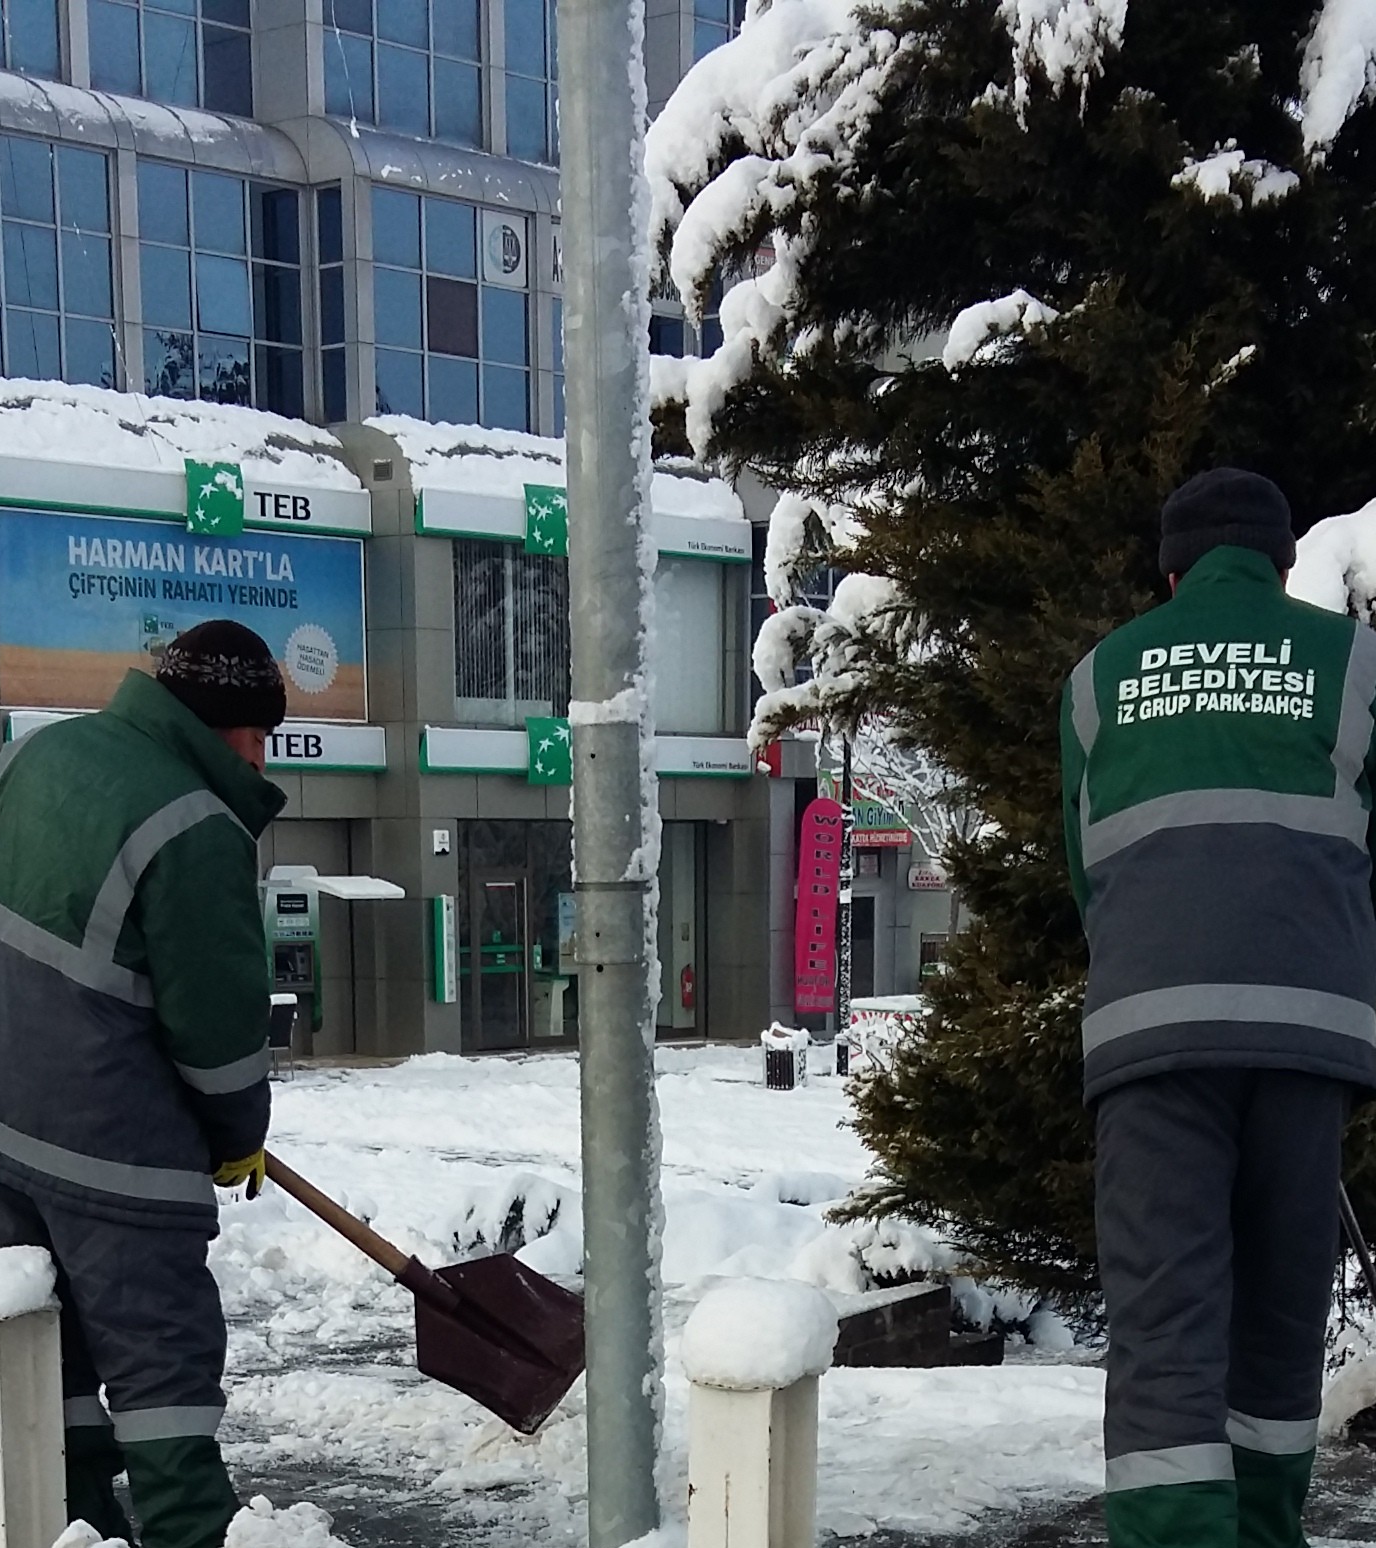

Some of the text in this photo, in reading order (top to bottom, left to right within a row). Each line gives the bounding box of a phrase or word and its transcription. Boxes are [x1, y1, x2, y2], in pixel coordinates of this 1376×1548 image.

[254, 491, 311, 521] TEB
[68, 535, 295, 582] HARMAN KART'LA
[69, 572, 298, 610] ÇİFTÇİNİN RAHATI YERİNDE
[1141, 638, 1291, 671] DEVELİ
[1118, 664, 1315, 702] BELEDİYESİ
[1139, 694, 1191, 721] GRUP
[1195, 692, 1314, 721] PARK-BAHÇE
[271, 733, 323, 758] TEB
